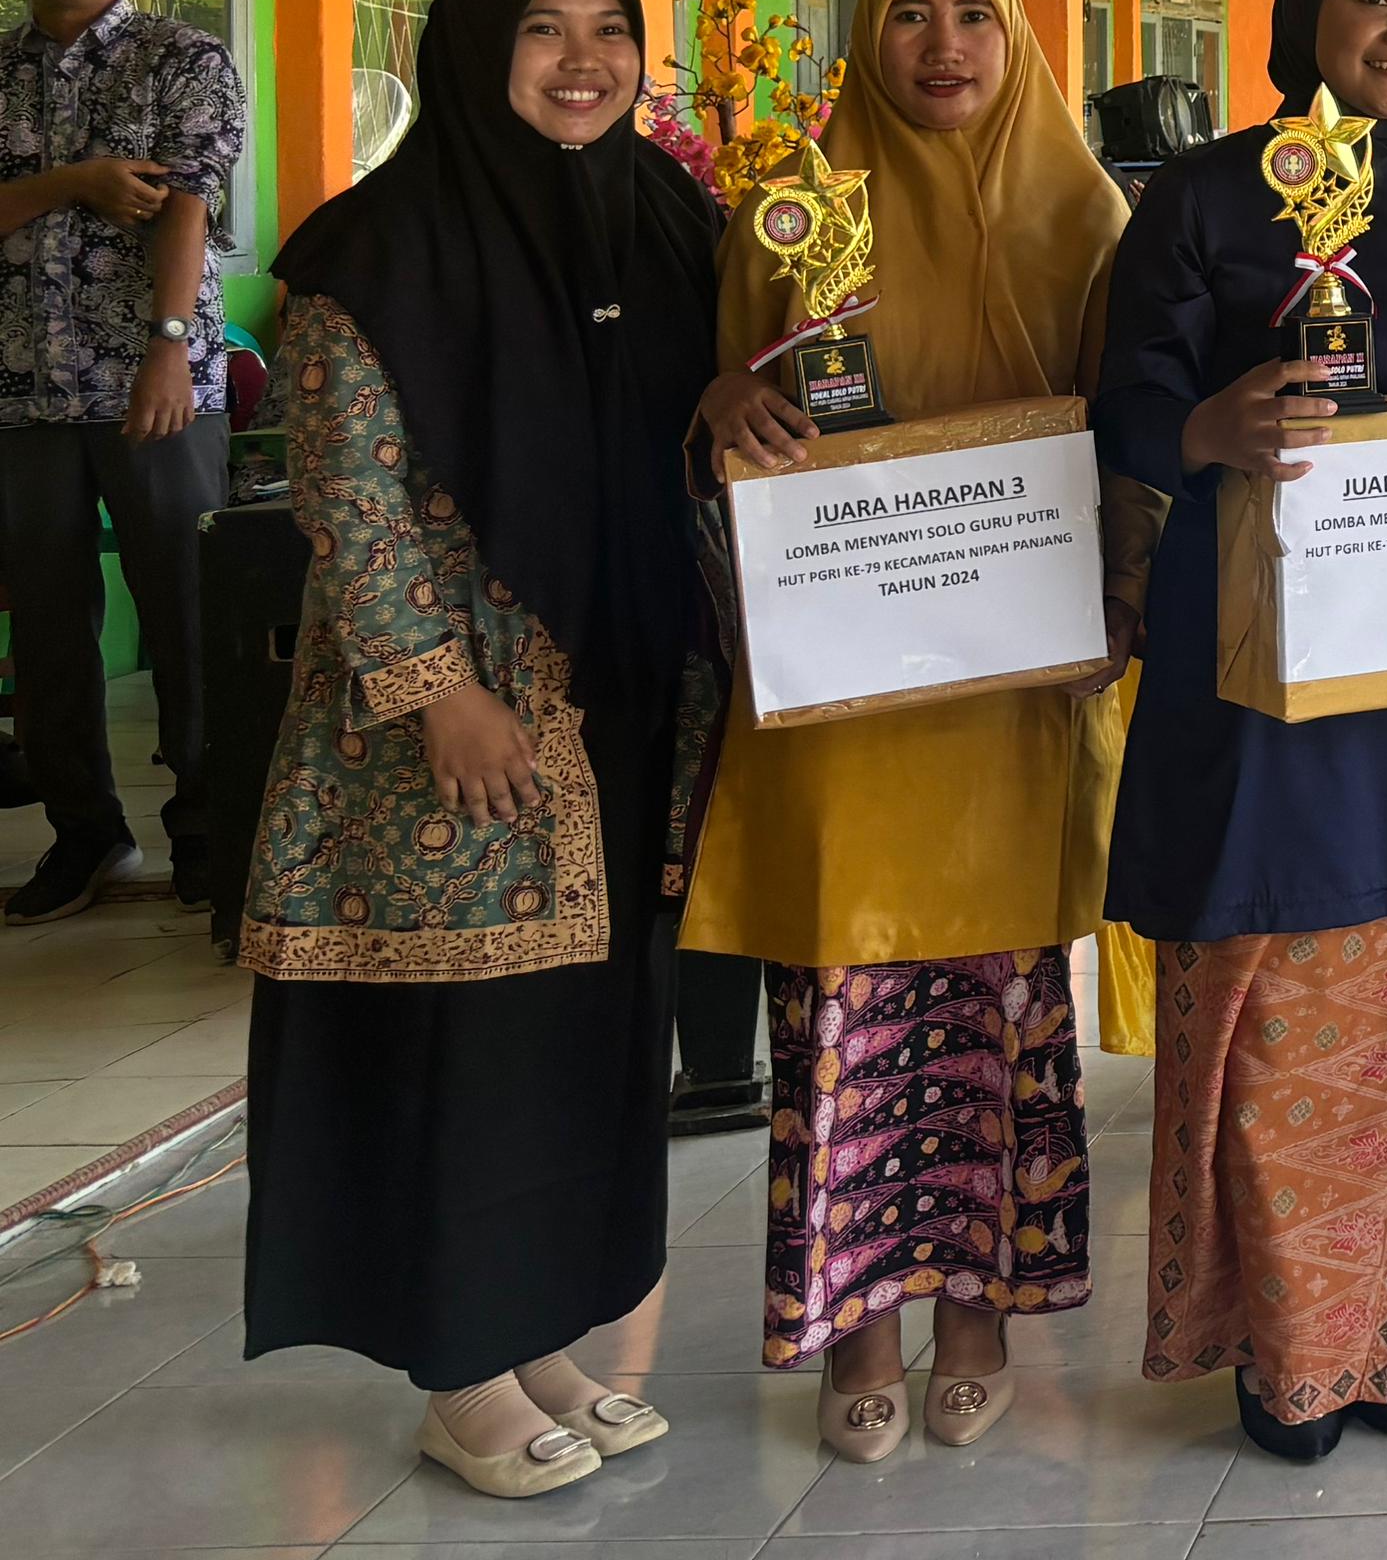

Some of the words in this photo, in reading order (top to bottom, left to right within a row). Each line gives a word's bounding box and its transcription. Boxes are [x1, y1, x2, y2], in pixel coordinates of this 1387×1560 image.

[813, 501, 888, 524] JUARA
[895, 479, 1005, 513] HARAPAN
[1012, 476, 1026, 494] 3
[785, 541, 840, 560] LOMBA
[844, 528, 922, 551] MENYANYI
[926, 522, 965, 539] SOLO
[969, 514, 1012, 532] GURU
[1016, 507, 1059, 525] PUTRI
[1314, 515, 1365, 531] LOMBA
[777, 573, 805, 587] HUT
[809, 567, 840, 582] PGRI
[844, 561, 880, 577] KE-79
[884, 548, 965, 570] KECAMATAN
[968, 542, 1009, 558] NIPAH
[1012, 532, 1072, 551] PANJANG
[1305, 545, 1331, 558] HUT
[1335, 542, 1363, 554] PGRI
[877, 575, 935, 596] TAHUN
[940, 568, 979, 586] 2024
